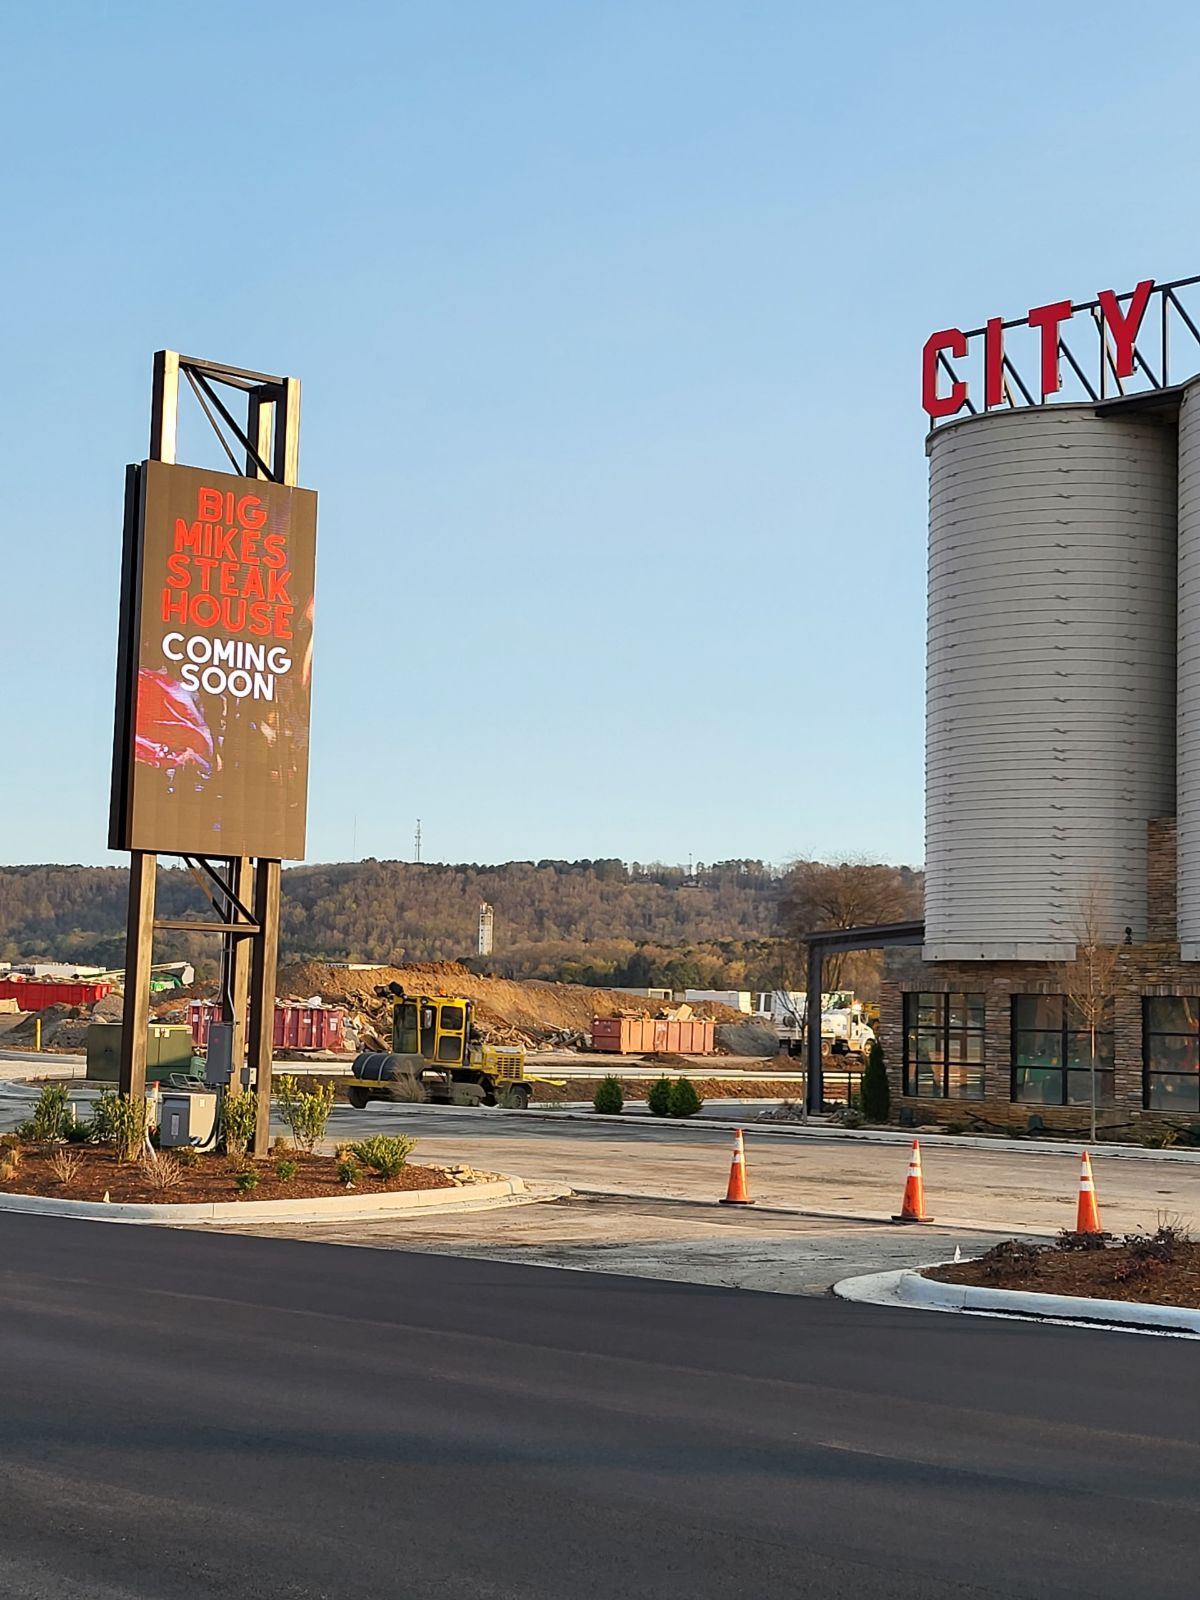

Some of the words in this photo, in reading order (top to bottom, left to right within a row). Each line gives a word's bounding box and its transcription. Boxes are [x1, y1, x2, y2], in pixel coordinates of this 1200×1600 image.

[922, 280, 1155, 418] CITY
[198, 487, 267, 529] BIG
[174, 518, 287, 569] MIKES
[166, 553, 292, 604] STEAK
[161, 588, 294, 640] HOUSE
[162, 632, 292, 675] COMING
[180, 664, 274, 701] SOON
